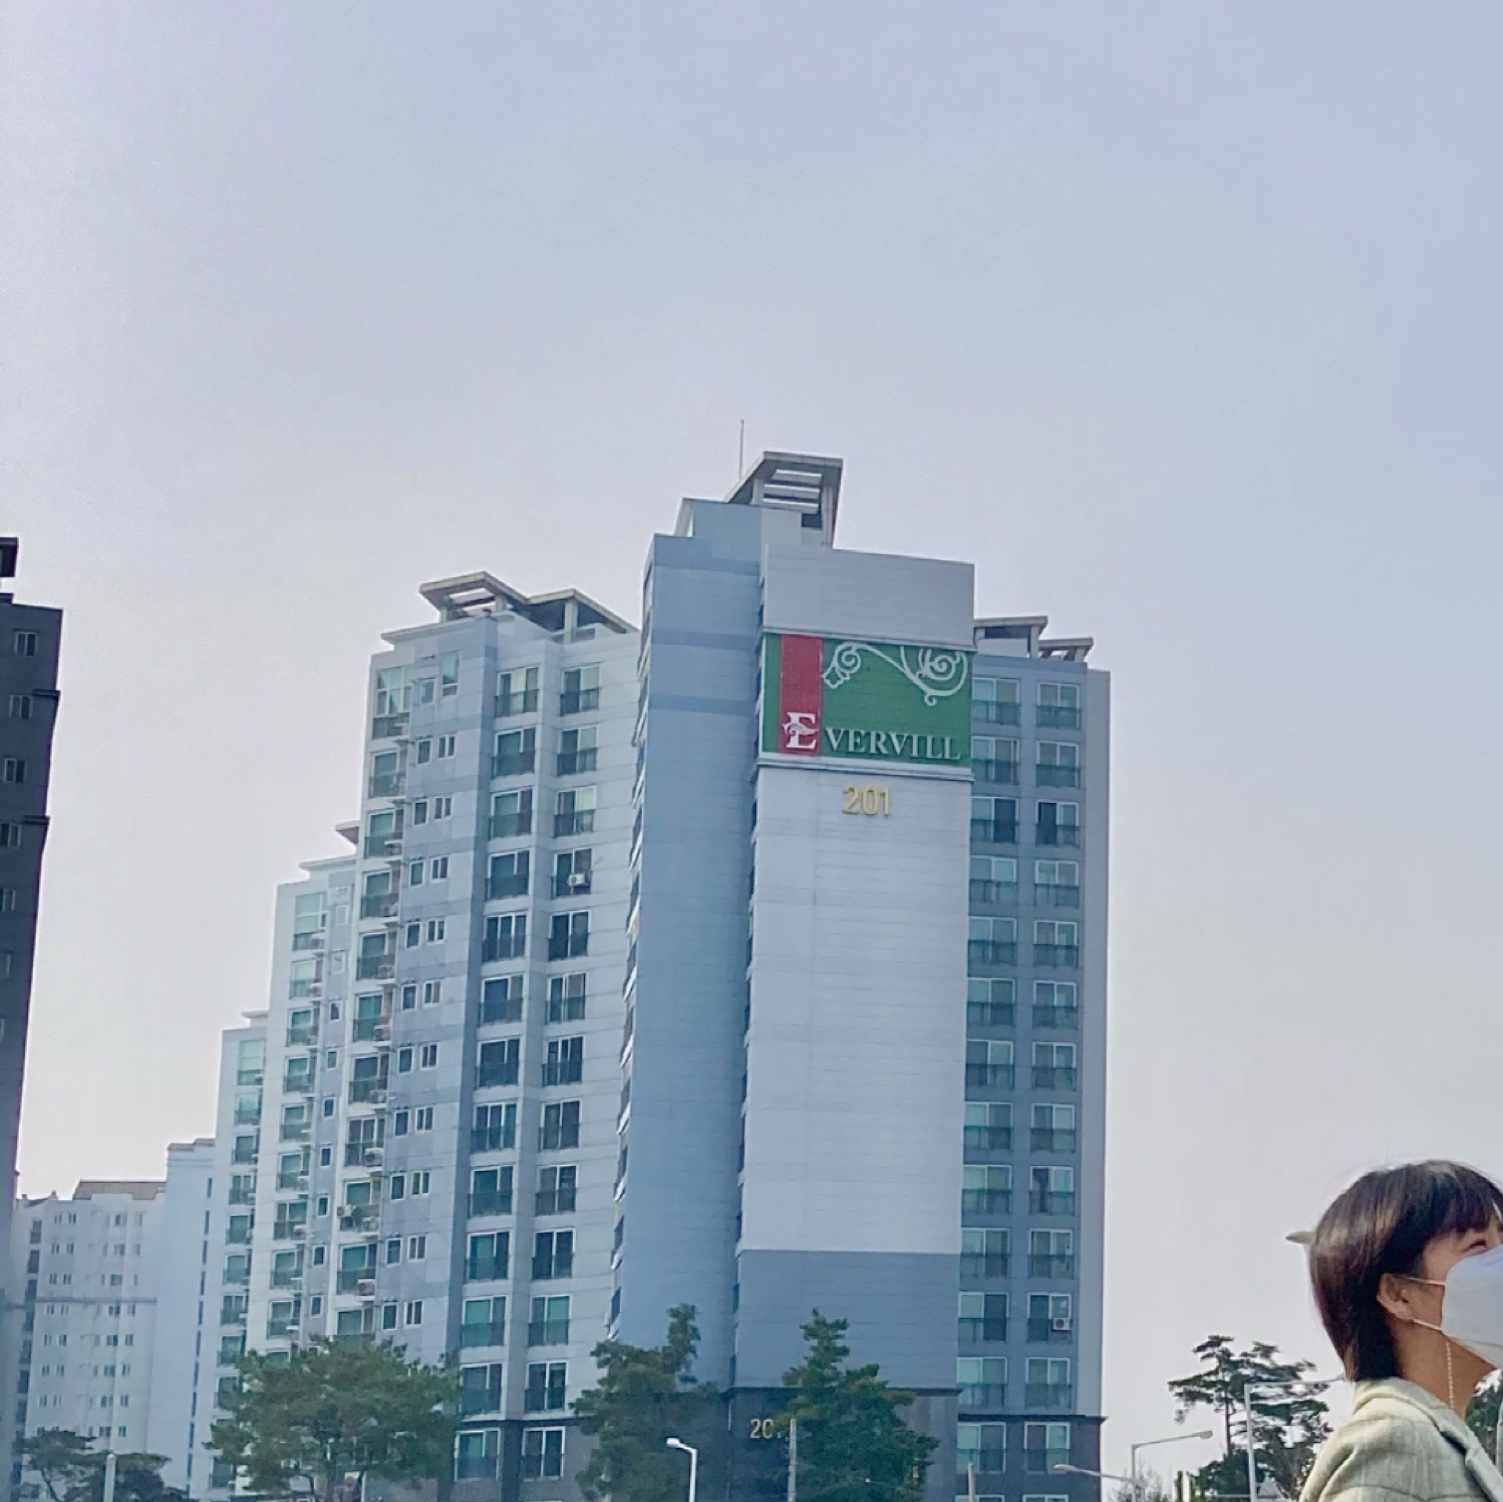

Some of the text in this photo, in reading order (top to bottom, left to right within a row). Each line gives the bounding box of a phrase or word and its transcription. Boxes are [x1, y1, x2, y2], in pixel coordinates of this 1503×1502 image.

[781, 711, 961, 760] EVERVILL
[842, 784, 891, 817] 201
[750, 1418, 782, 1439] 20
